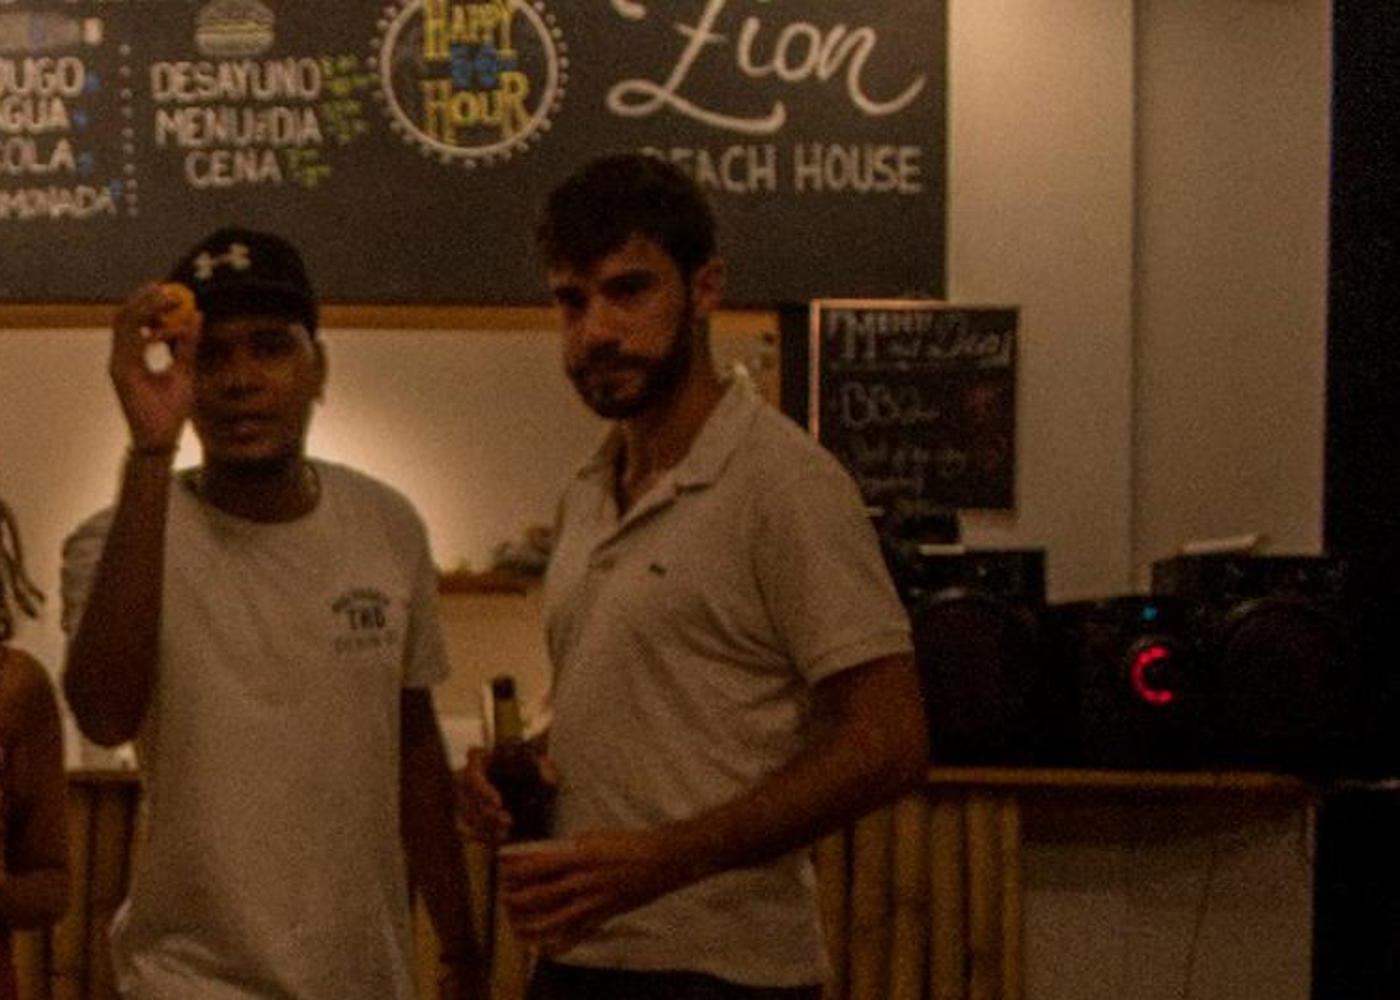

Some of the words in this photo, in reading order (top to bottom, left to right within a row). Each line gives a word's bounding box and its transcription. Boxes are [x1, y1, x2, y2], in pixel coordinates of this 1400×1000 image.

[151, 57, 321, 102] DESAYUNO
[185, 149, 283, 189] CENA
[794, 144, 924, 193] HOUSE
